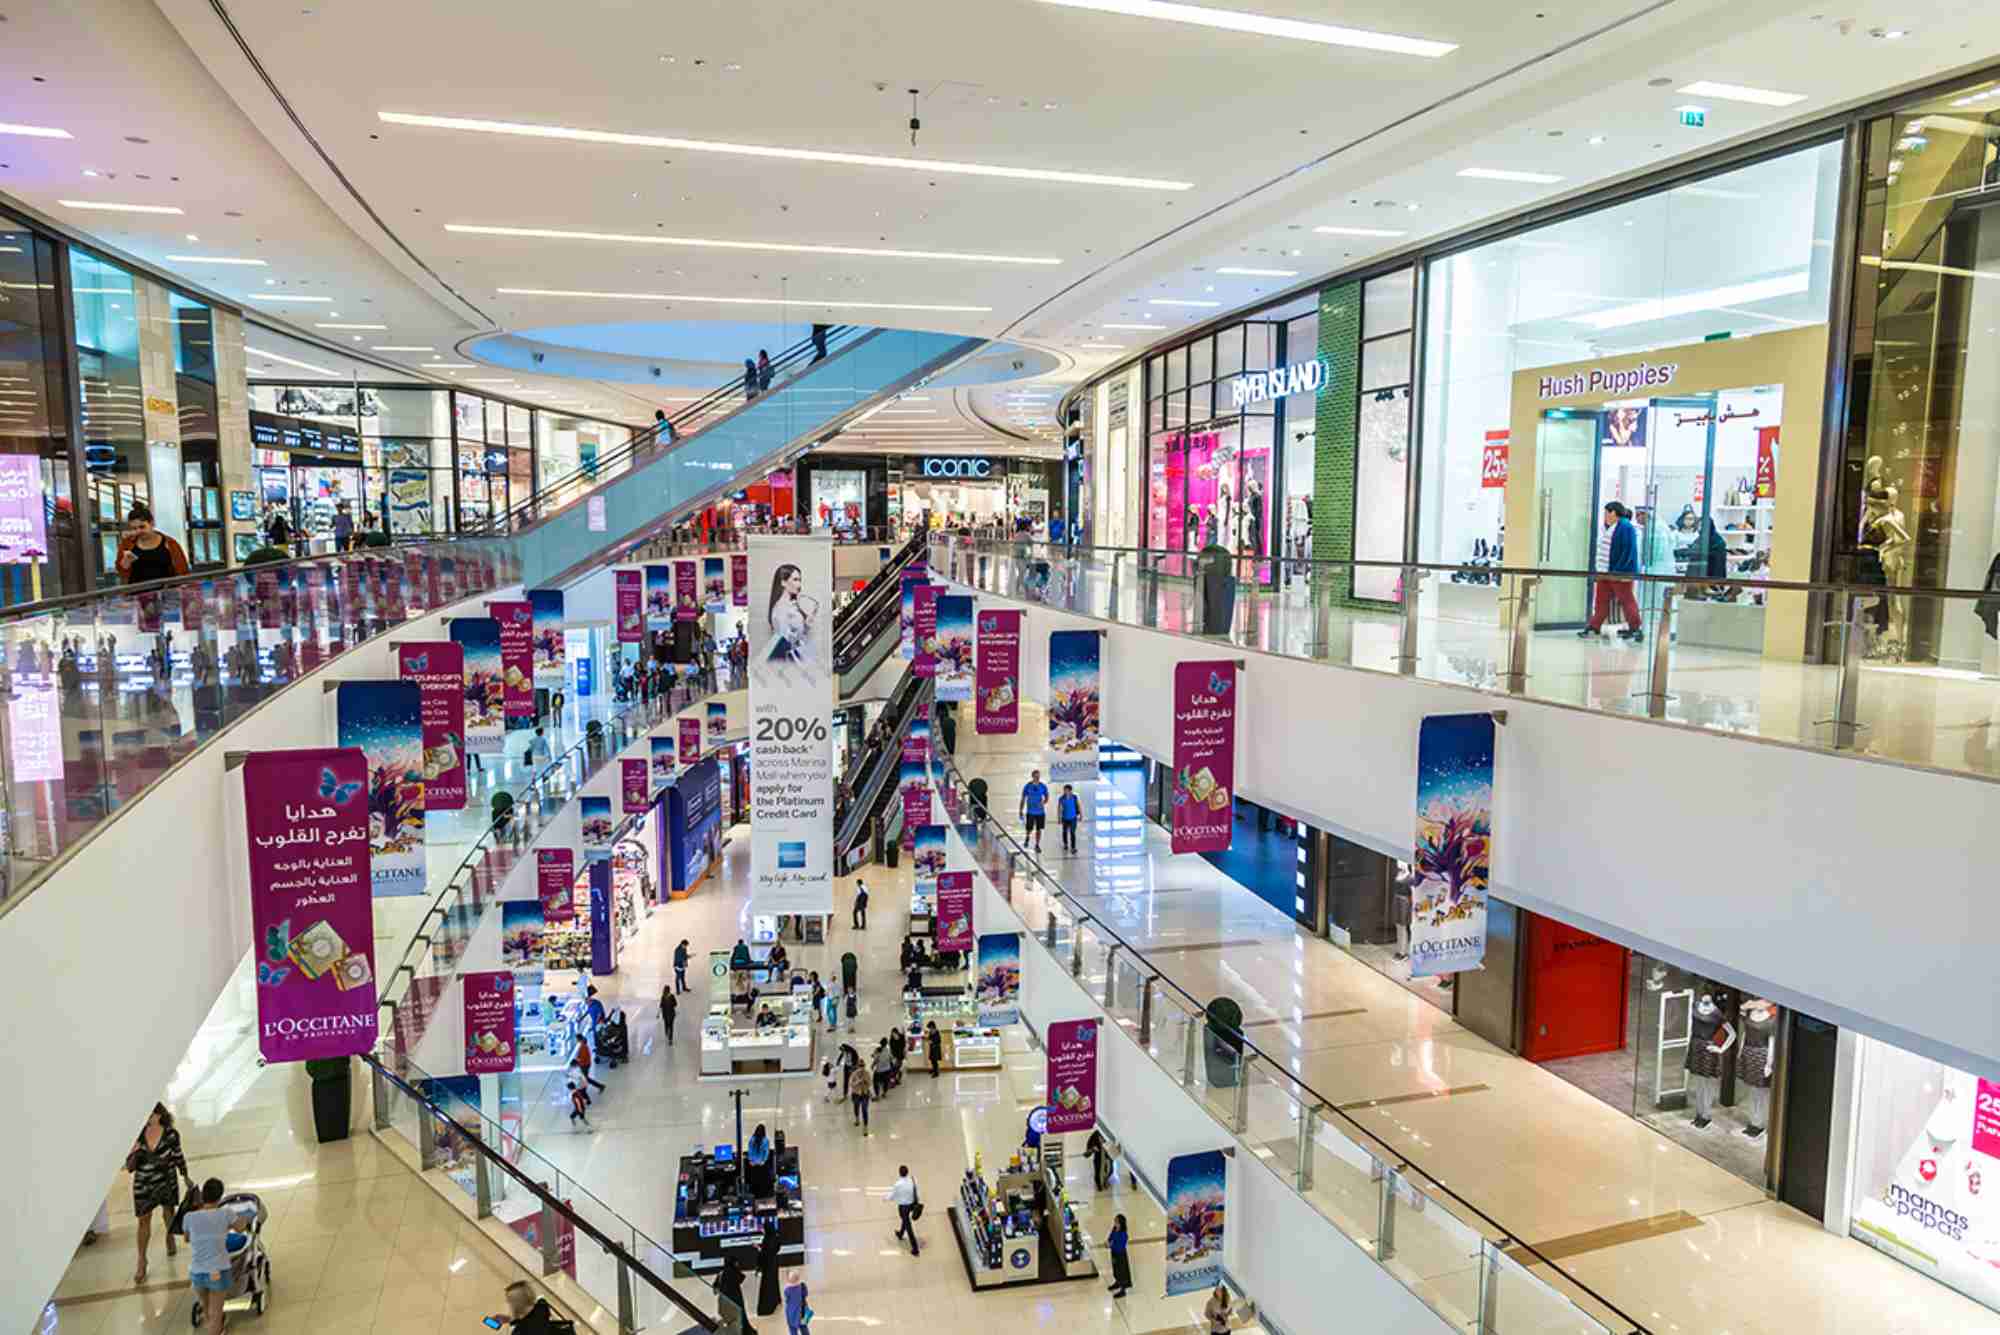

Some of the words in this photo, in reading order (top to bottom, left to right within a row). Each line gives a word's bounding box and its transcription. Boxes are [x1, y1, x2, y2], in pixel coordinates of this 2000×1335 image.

[1232, 374, 1267, 407] RIVER
[1269, 360, 1320, 400] ISLAND
[1539, 373, 1584, 397] Hush
[1191, 693, 1218, 705] هدايا
[755, 703, 778, 713] with
[1176, 708, 1209, 721] القلوب
[1210, 708, 1232, 720] تفرح
[756, 717, 827, 741] 20%
[755, 744, 781, 754] cash
[755, 759, 789, 768] across
[791, 758, 826, 768] Marina
[756, 771, 776, 780] Mall
[779, 771, 803, 780] when
[804, 772, 826, 782] you
[756, 784, 785, 795] apply
[787, 783, 803, 793] for
[756, 797, 774, 806] the
[776, 797, 825, 806] Platinum
[285, 804, 337, 823] هدايا
[756, 809, 789, 819] Credit
[791, 808, 818, 819] Card
[256, 827, 320, 848] القلوب
[325, 826, 366, 845] تفرح
[1174, 824, 1229, 838] L'OCCITANE
[273, 859, 311, 871] بالوجه
[313, 856, 353, 870] العناية
[269, 877, 317, 891] بالجسم
[318, 873, 358, 886] العناية
[295, 893, 336, 908] العطور
[1413, 936, 1481, 955] L'OCCITANE
[264, 1014, 376, 1037] L'OCCITANE
[1891, 1183, 1969, 1230] mamas
[1896, 1200, 1963, 1241] papas
